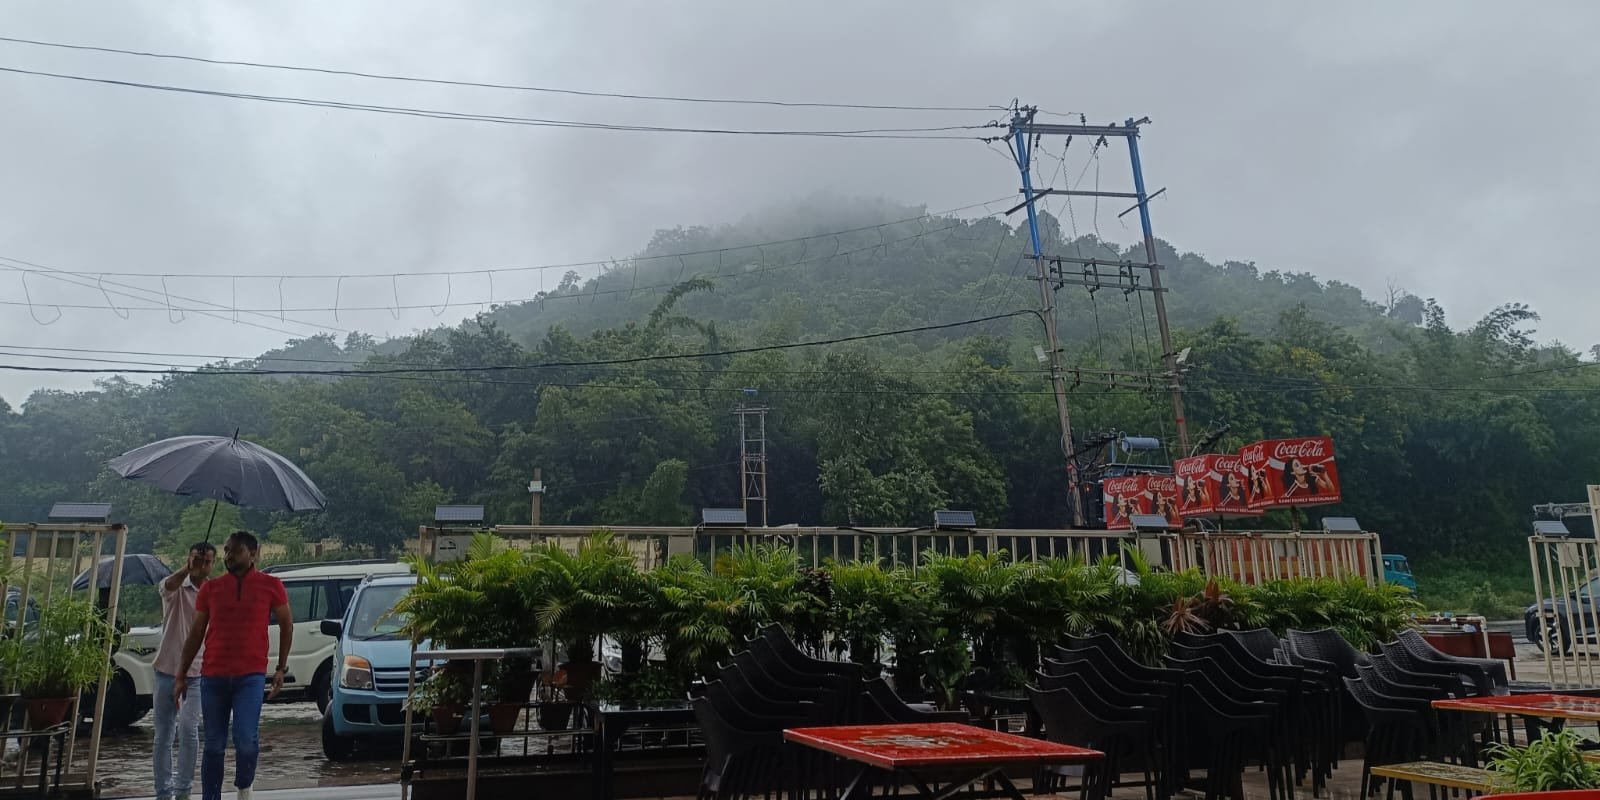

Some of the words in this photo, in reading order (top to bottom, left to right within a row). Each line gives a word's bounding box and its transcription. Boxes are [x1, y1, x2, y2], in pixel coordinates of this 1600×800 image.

[1243, 445, 1264, 465] Coca-Cola
[1275, 440, 1324, 459] Coca-Cola
[1179, 457, 1205, 476] Coca-Cola
[1108, 478, 1138, 494] Coca-Cola
